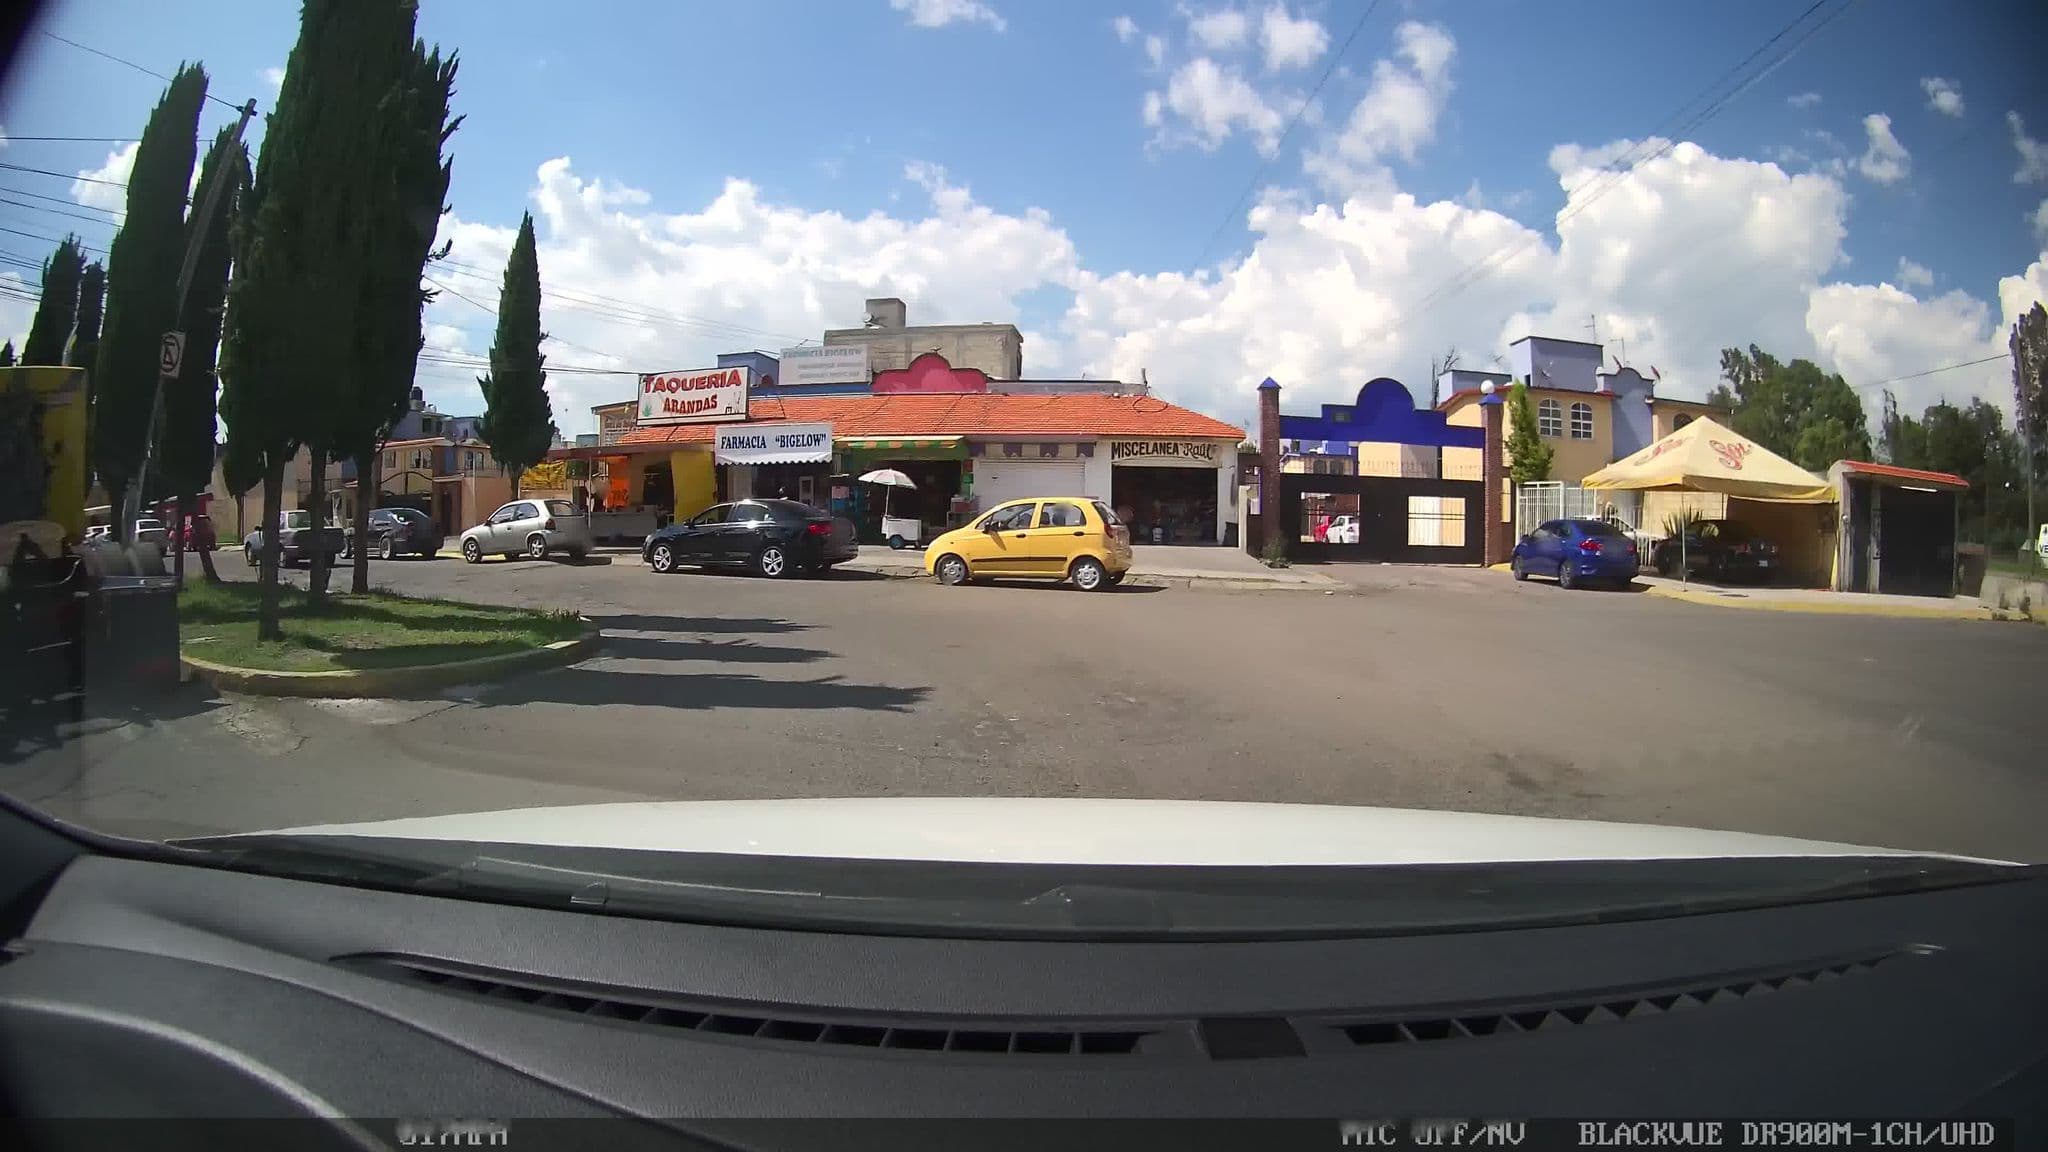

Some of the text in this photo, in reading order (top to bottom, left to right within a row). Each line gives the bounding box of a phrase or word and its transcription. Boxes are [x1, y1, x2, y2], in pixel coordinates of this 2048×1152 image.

[643, 369, 741, 393] TAQUERIA
[663, 394, 718, 414] ARANDAS
[721, 433, 826, 449] FARMACIA "BIGELOW"
[1111, 442, 1179, 460] MISCELANEA
